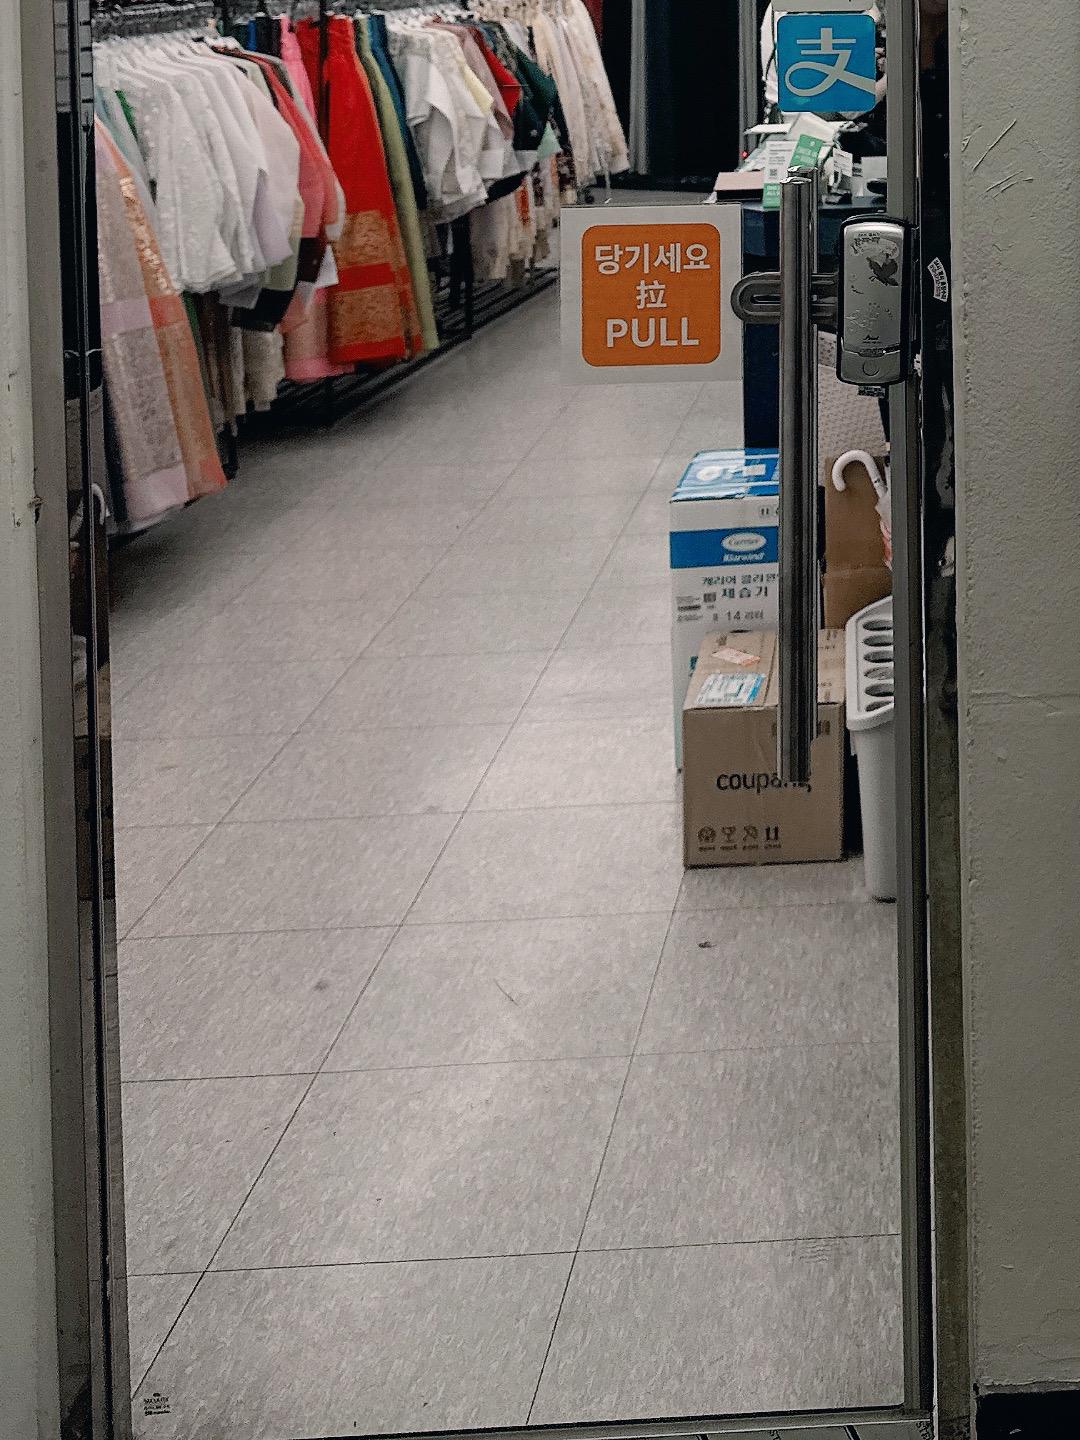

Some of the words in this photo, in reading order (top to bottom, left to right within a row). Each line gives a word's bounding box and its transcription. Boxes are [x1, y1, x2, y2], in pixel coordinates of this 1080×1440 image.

[594, 242, 711, 275] 당기세요
[635, 279, 668, 310] 拉
[606, 317, 700, 348] PULL
[716, 772, 812, 794] coupa
